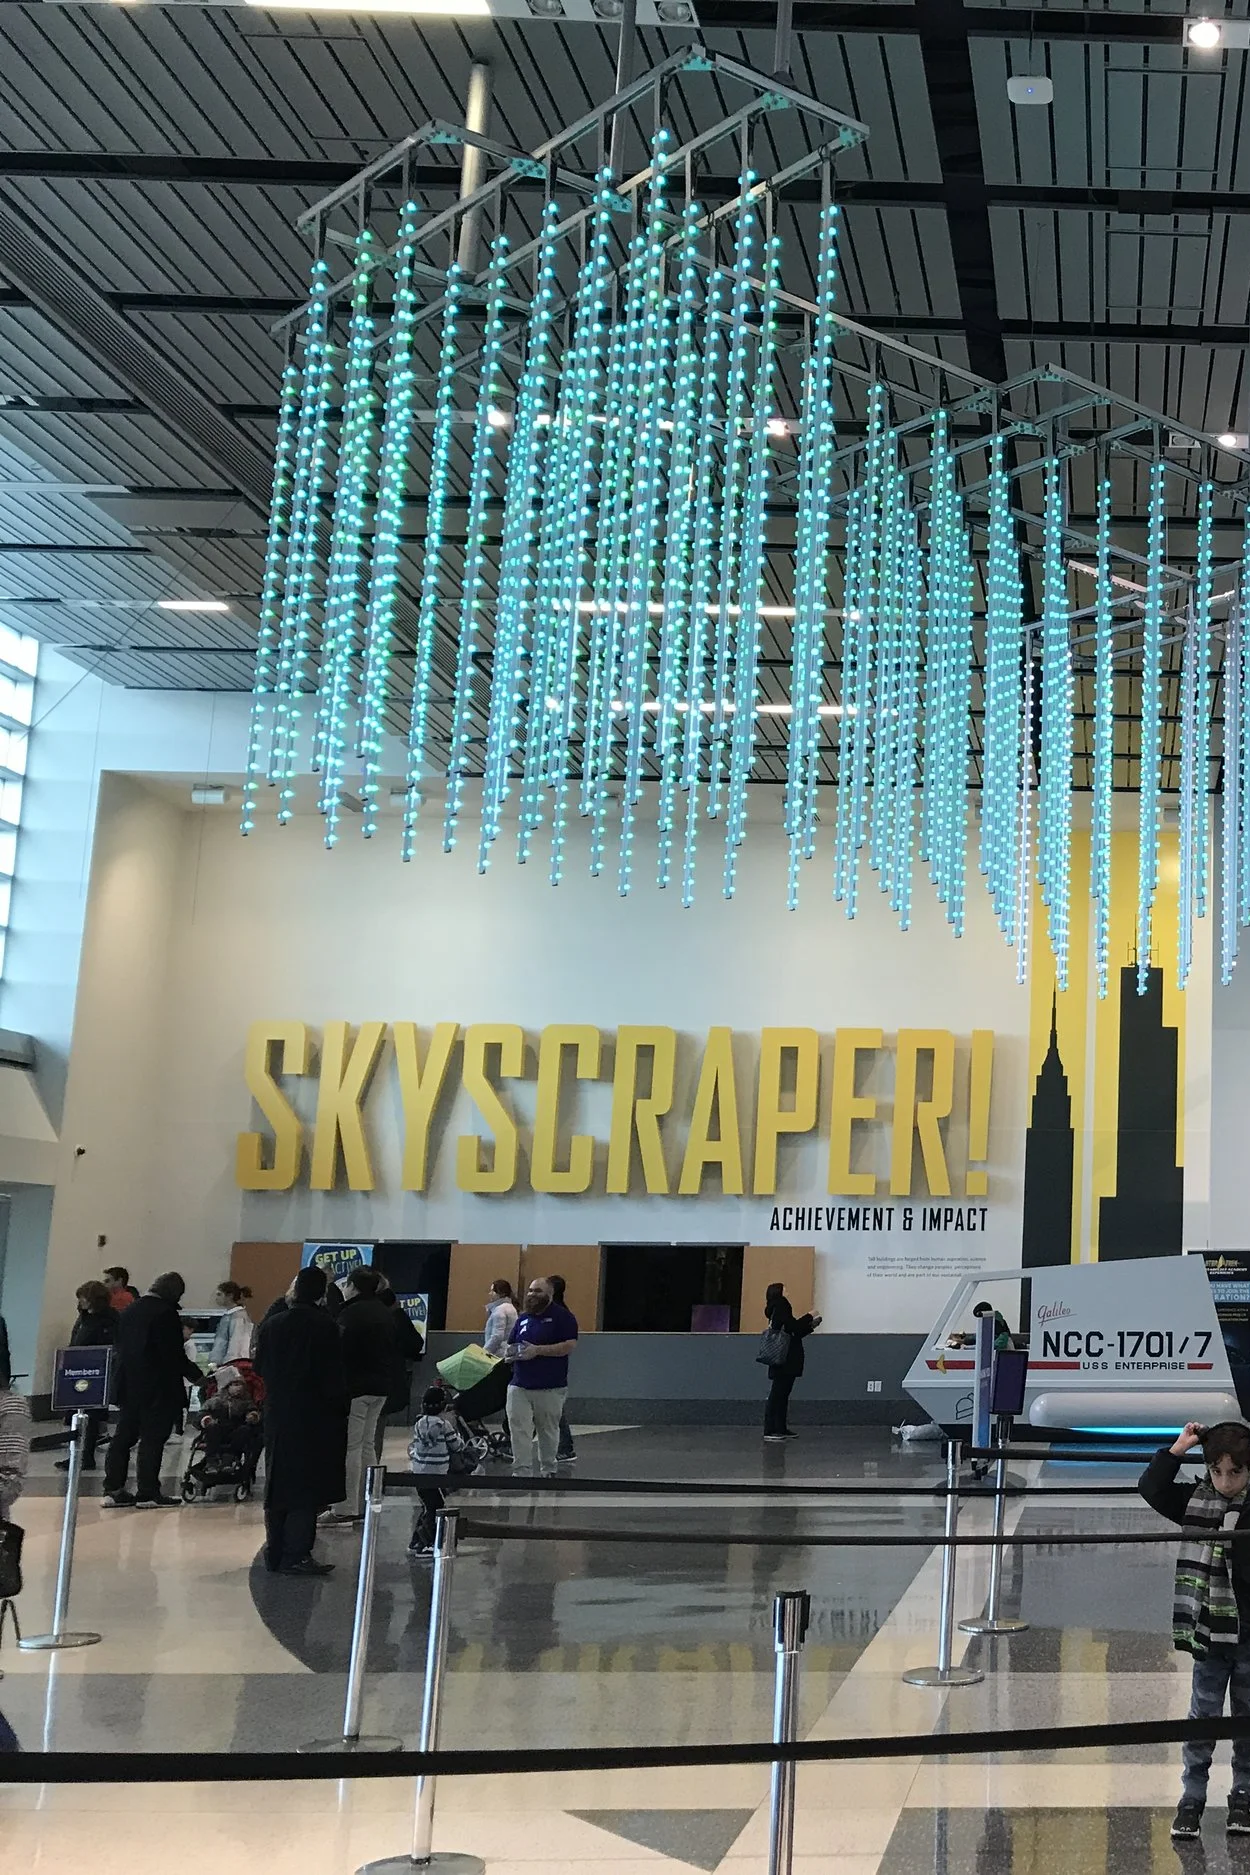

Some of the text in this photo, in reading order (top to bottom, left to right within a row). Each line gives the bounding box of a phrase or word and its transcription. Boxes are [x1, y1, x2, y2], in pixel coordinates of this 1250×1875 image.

[235, 1021, 994, 1196] SKYSCRAPER!
[769, 1207, 988, 1231] ACHIEVEMENT & IMPACT
[315, 1249, 357, 1264] GET UP
[407, 1297, 421, 1307] UP
[1037, 1301, 1072, 1324] Galileo
[1042, 1331, 1213, 1358] NCC-1701/7
[64, 1368, 100, 1376] Members
[1082, 1361, 1185, 1370] USS ENTERPRISE
